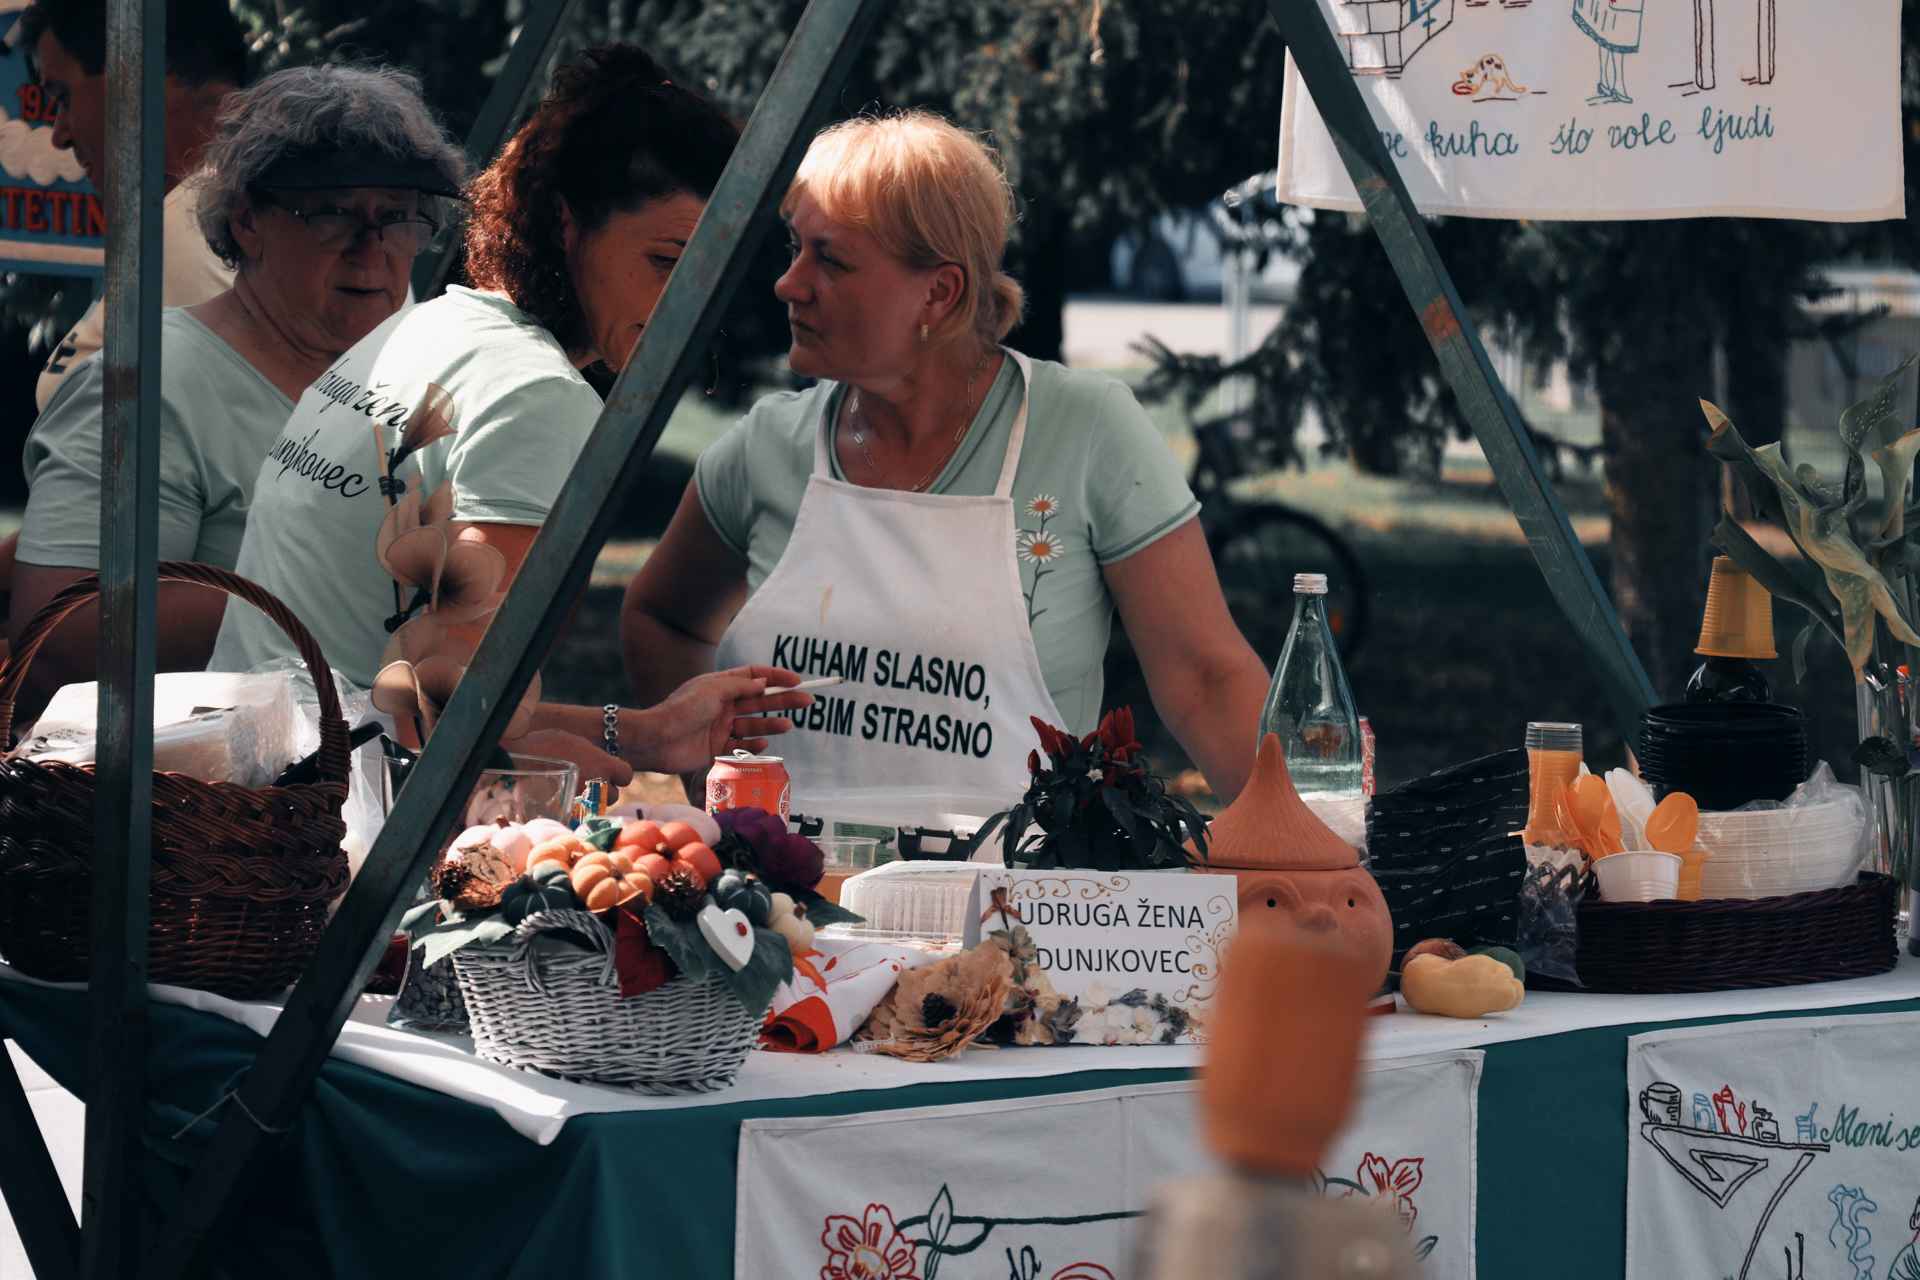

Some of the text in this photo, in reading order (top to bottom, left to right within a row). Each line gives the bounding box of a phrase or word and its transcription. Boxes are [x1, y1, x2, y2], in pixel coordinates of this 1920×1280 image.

[1424, 120, 1520, 158] kuha
[1607, 112, 1677, 150] vole
[1697, 104, 1775, 155] ljudi
[771, 634, 991, 711] KUHAM SLASNO,
[763, 694, 993, 759] UBIM STRASNO
[1017, 898, 1204, 929] UDRUGA ŽENA
[1035, 947, 1191, 974] DUNJKOVEC
